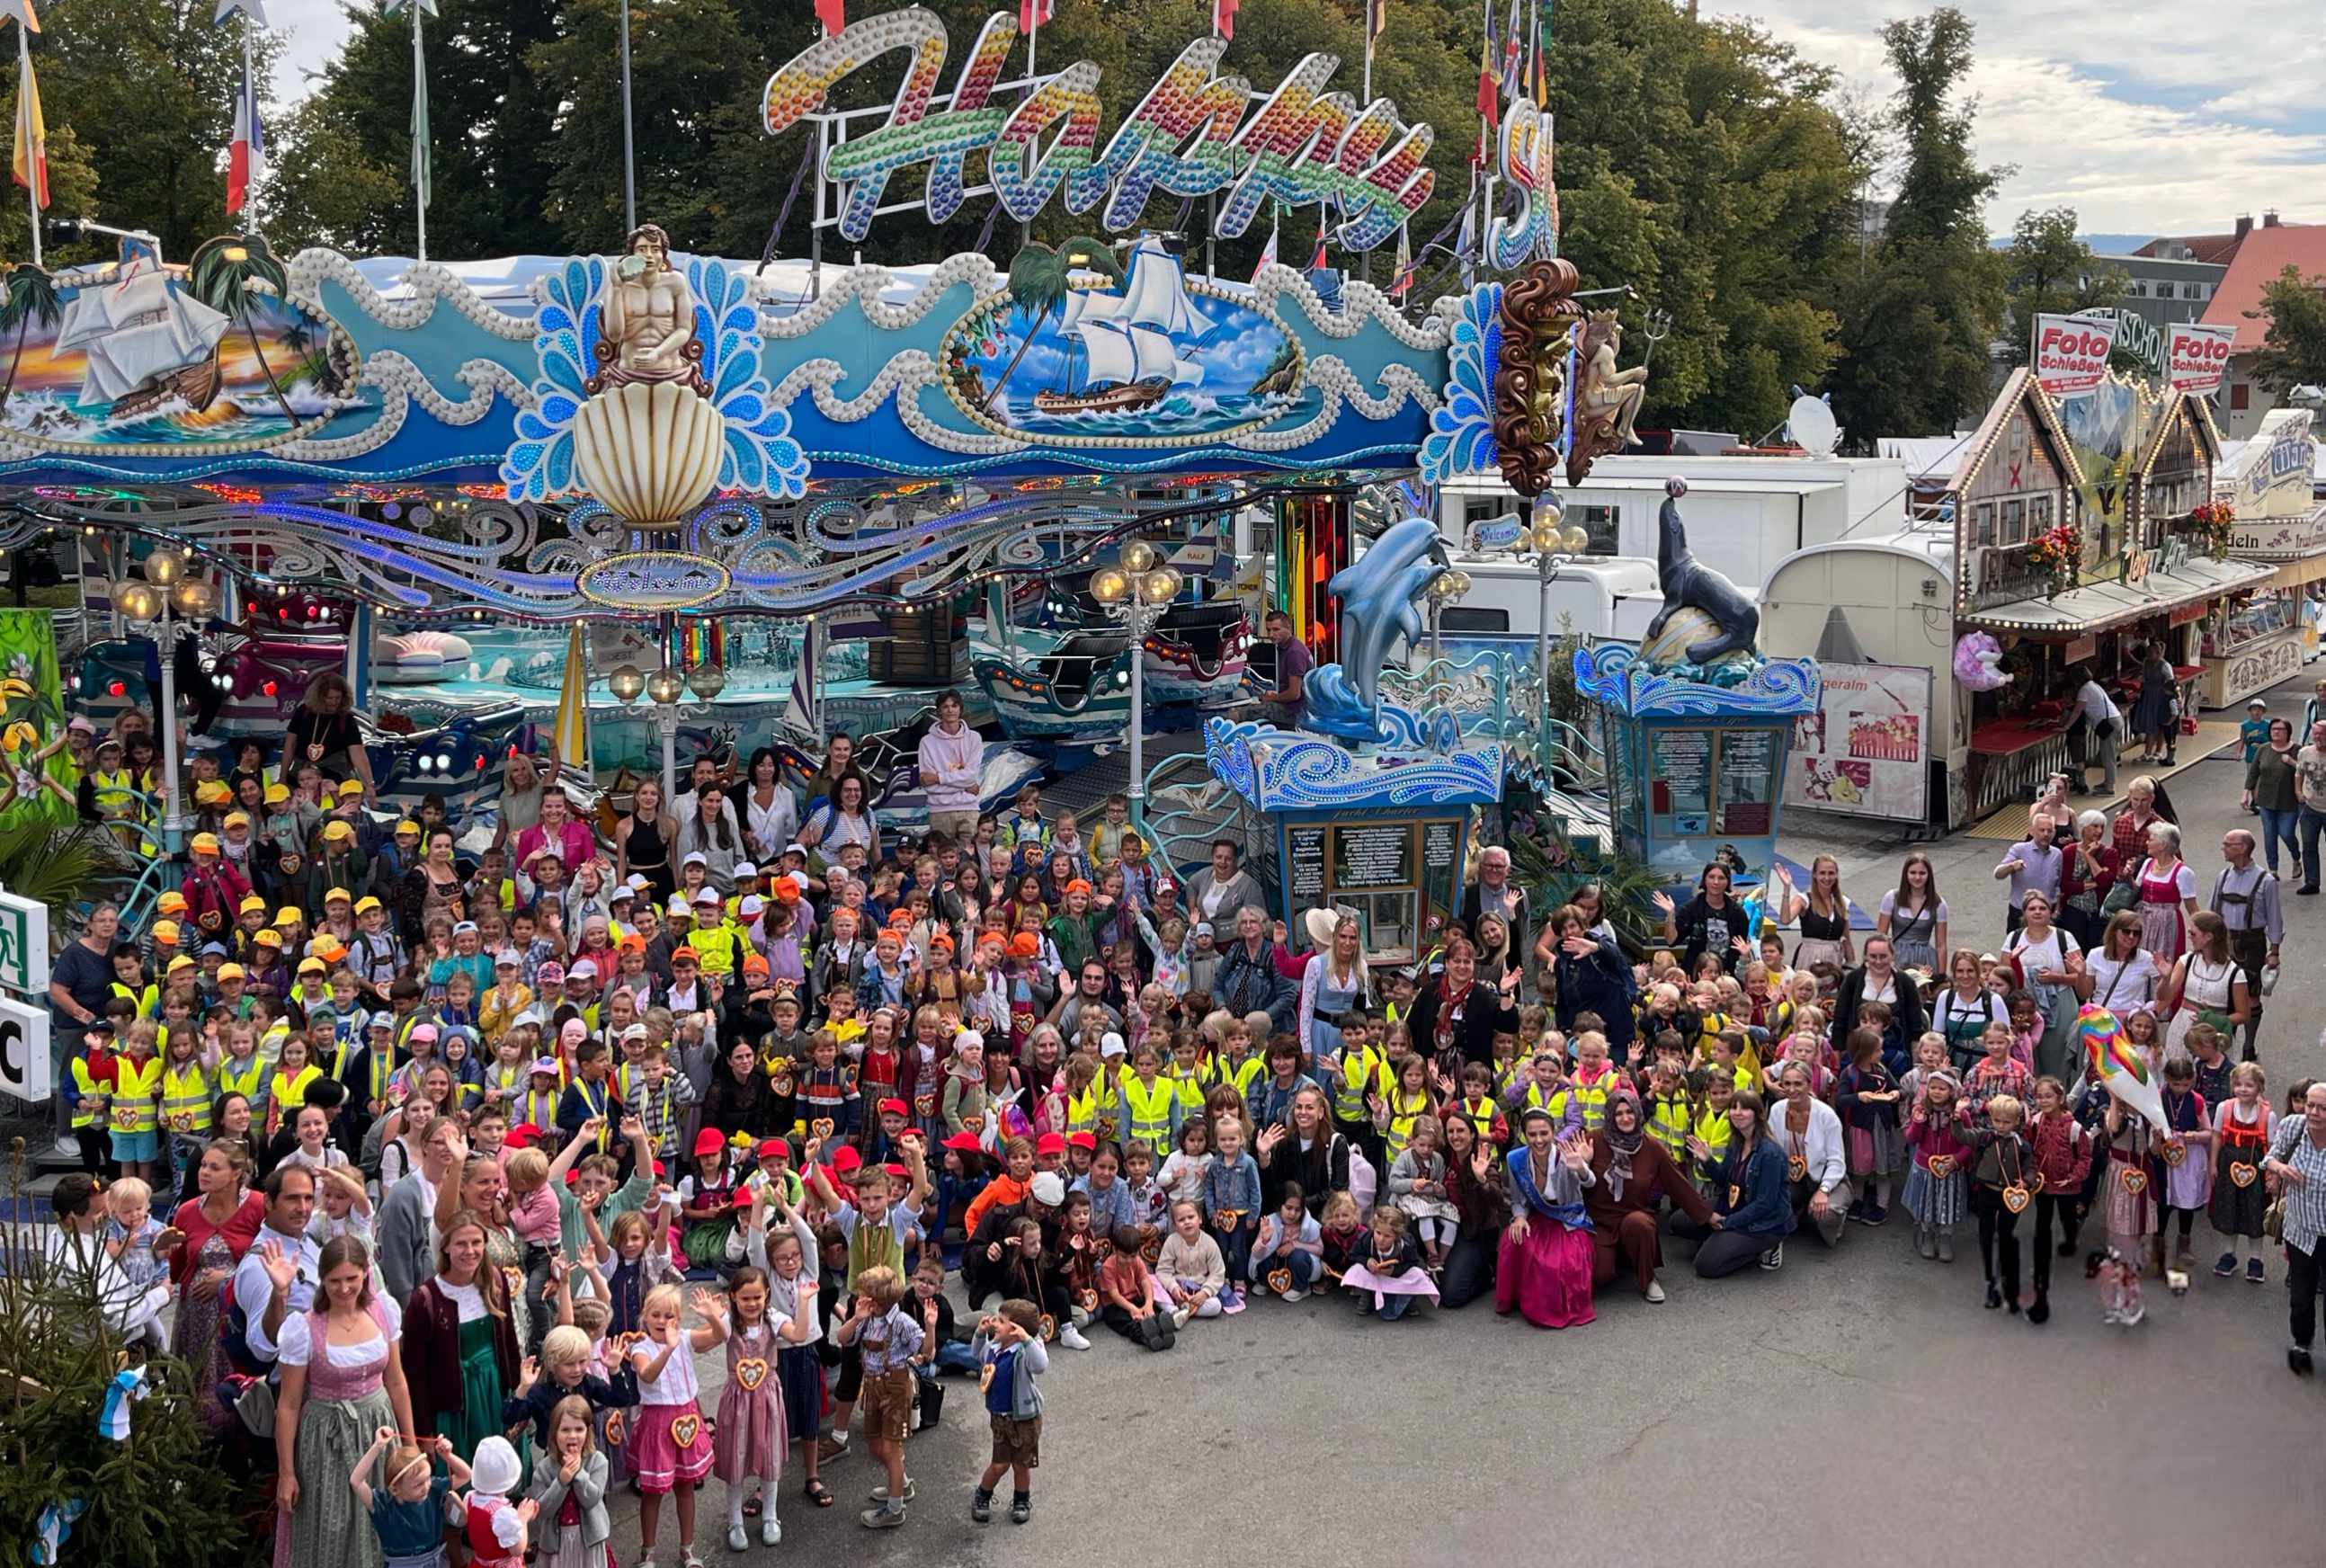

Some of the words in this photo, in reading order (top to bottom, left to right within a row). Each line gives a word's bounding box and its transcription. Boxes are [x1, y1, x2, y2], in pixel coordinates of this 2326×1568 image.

[762, 7, 1436, 253] Happy
[2040, 327, 2109, 358] Foto
[2171, 335, 2230, 360] Foto
[2039, 354, 2104, 374] Schießen
[2171, 359, 2224, 374] Schießen
[2225, 530, 2259, 548] deln
[591, 569, 719, 593] Welcome
[1822, 679, 1868, 691] geralm
